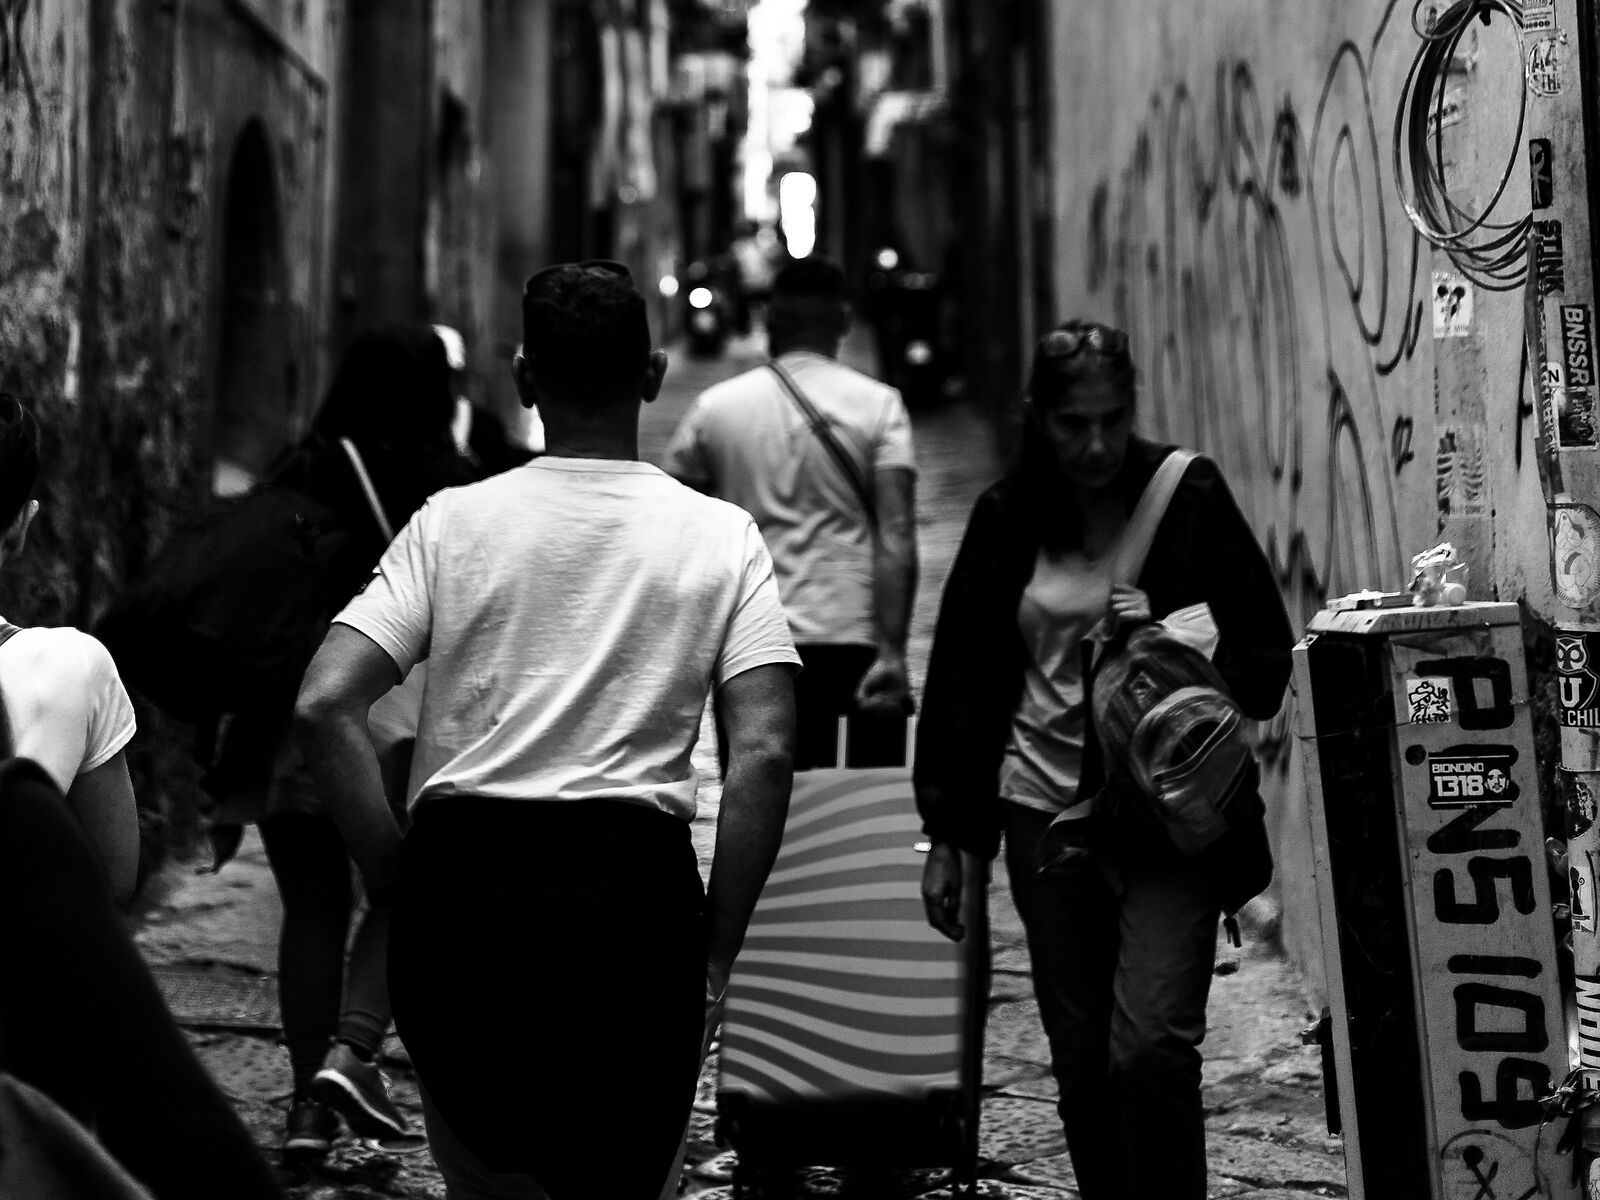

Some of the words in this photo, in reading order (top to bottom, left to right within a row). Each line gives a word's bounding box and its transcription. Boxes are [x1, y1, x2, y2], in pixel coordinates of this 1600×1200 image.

[1564, 307, 1590, 385] BNSSR
[1559, 677, 1583, 708] U
[1432, 762, 1484, 774] BIONDINO
[1434, 775, 1484, 797] 1318
